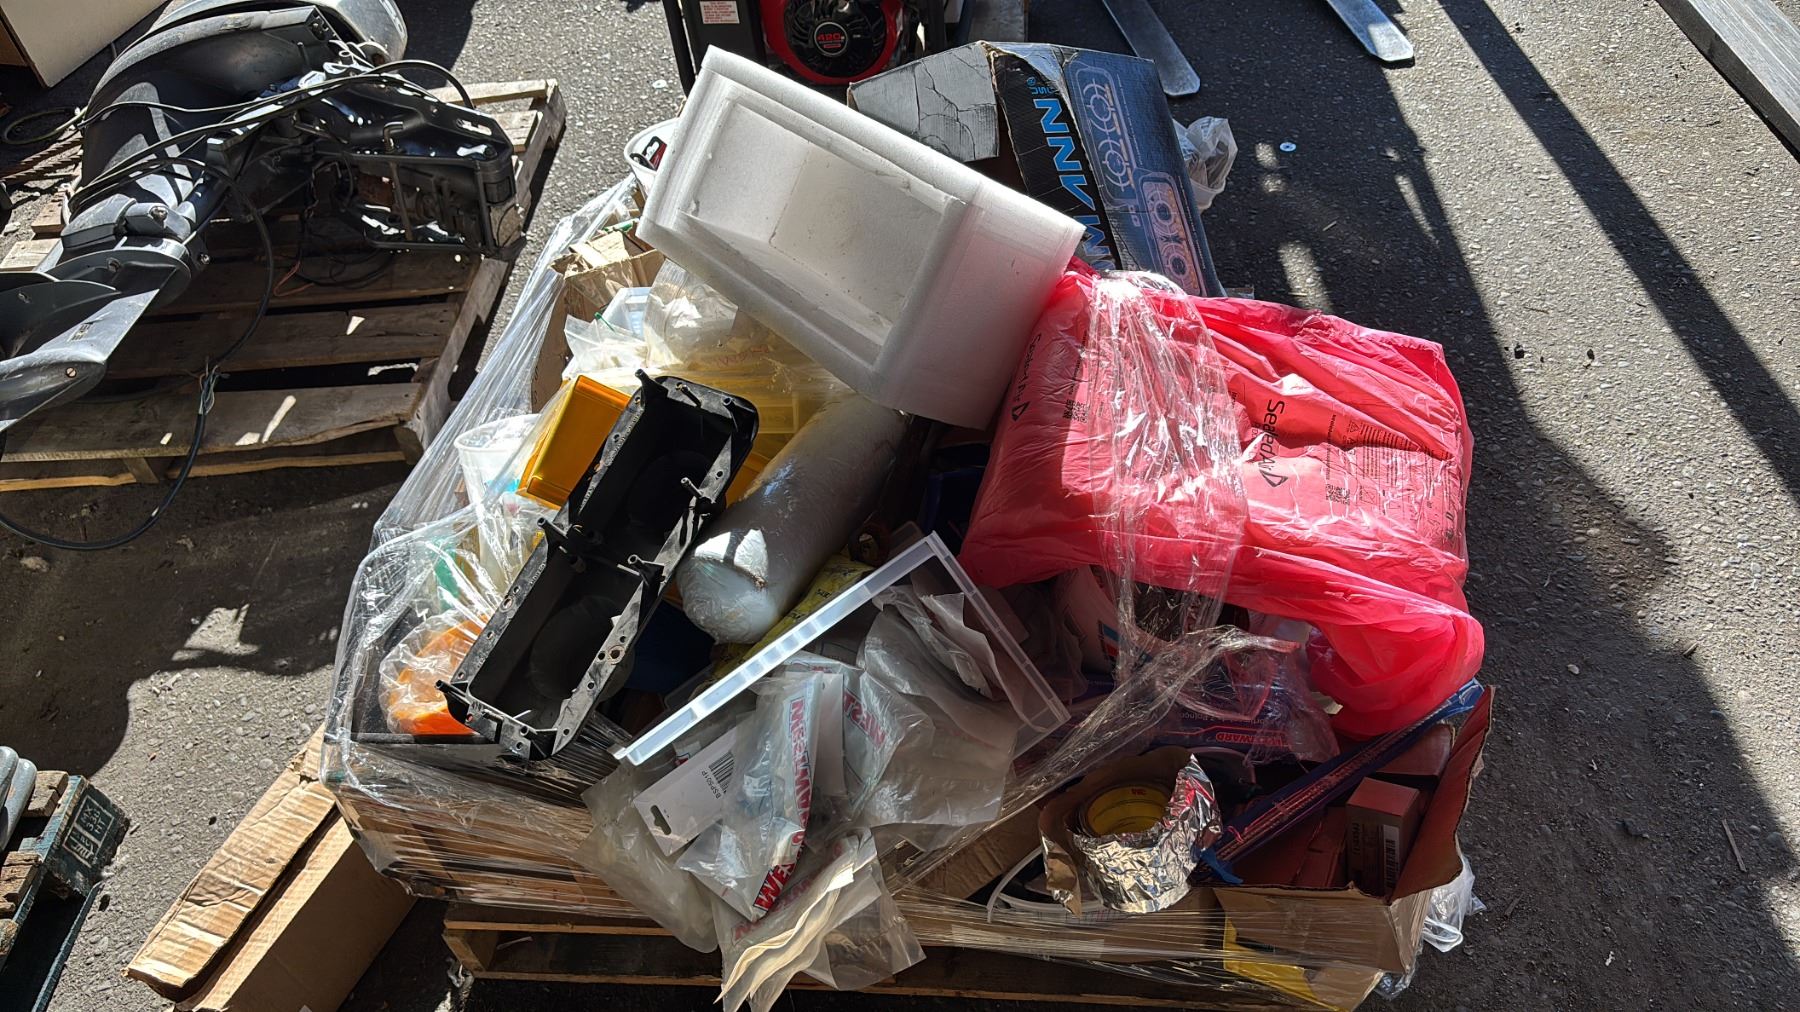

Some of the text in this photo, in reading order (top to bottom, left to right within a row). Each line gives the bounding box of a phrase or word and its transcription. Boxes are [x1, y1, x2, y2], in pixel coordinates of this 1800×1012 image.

[1260, 399, 1285, 456] Sealed
[80, 804, 94, 823] MX
[94, 817, 106, 834] HT
